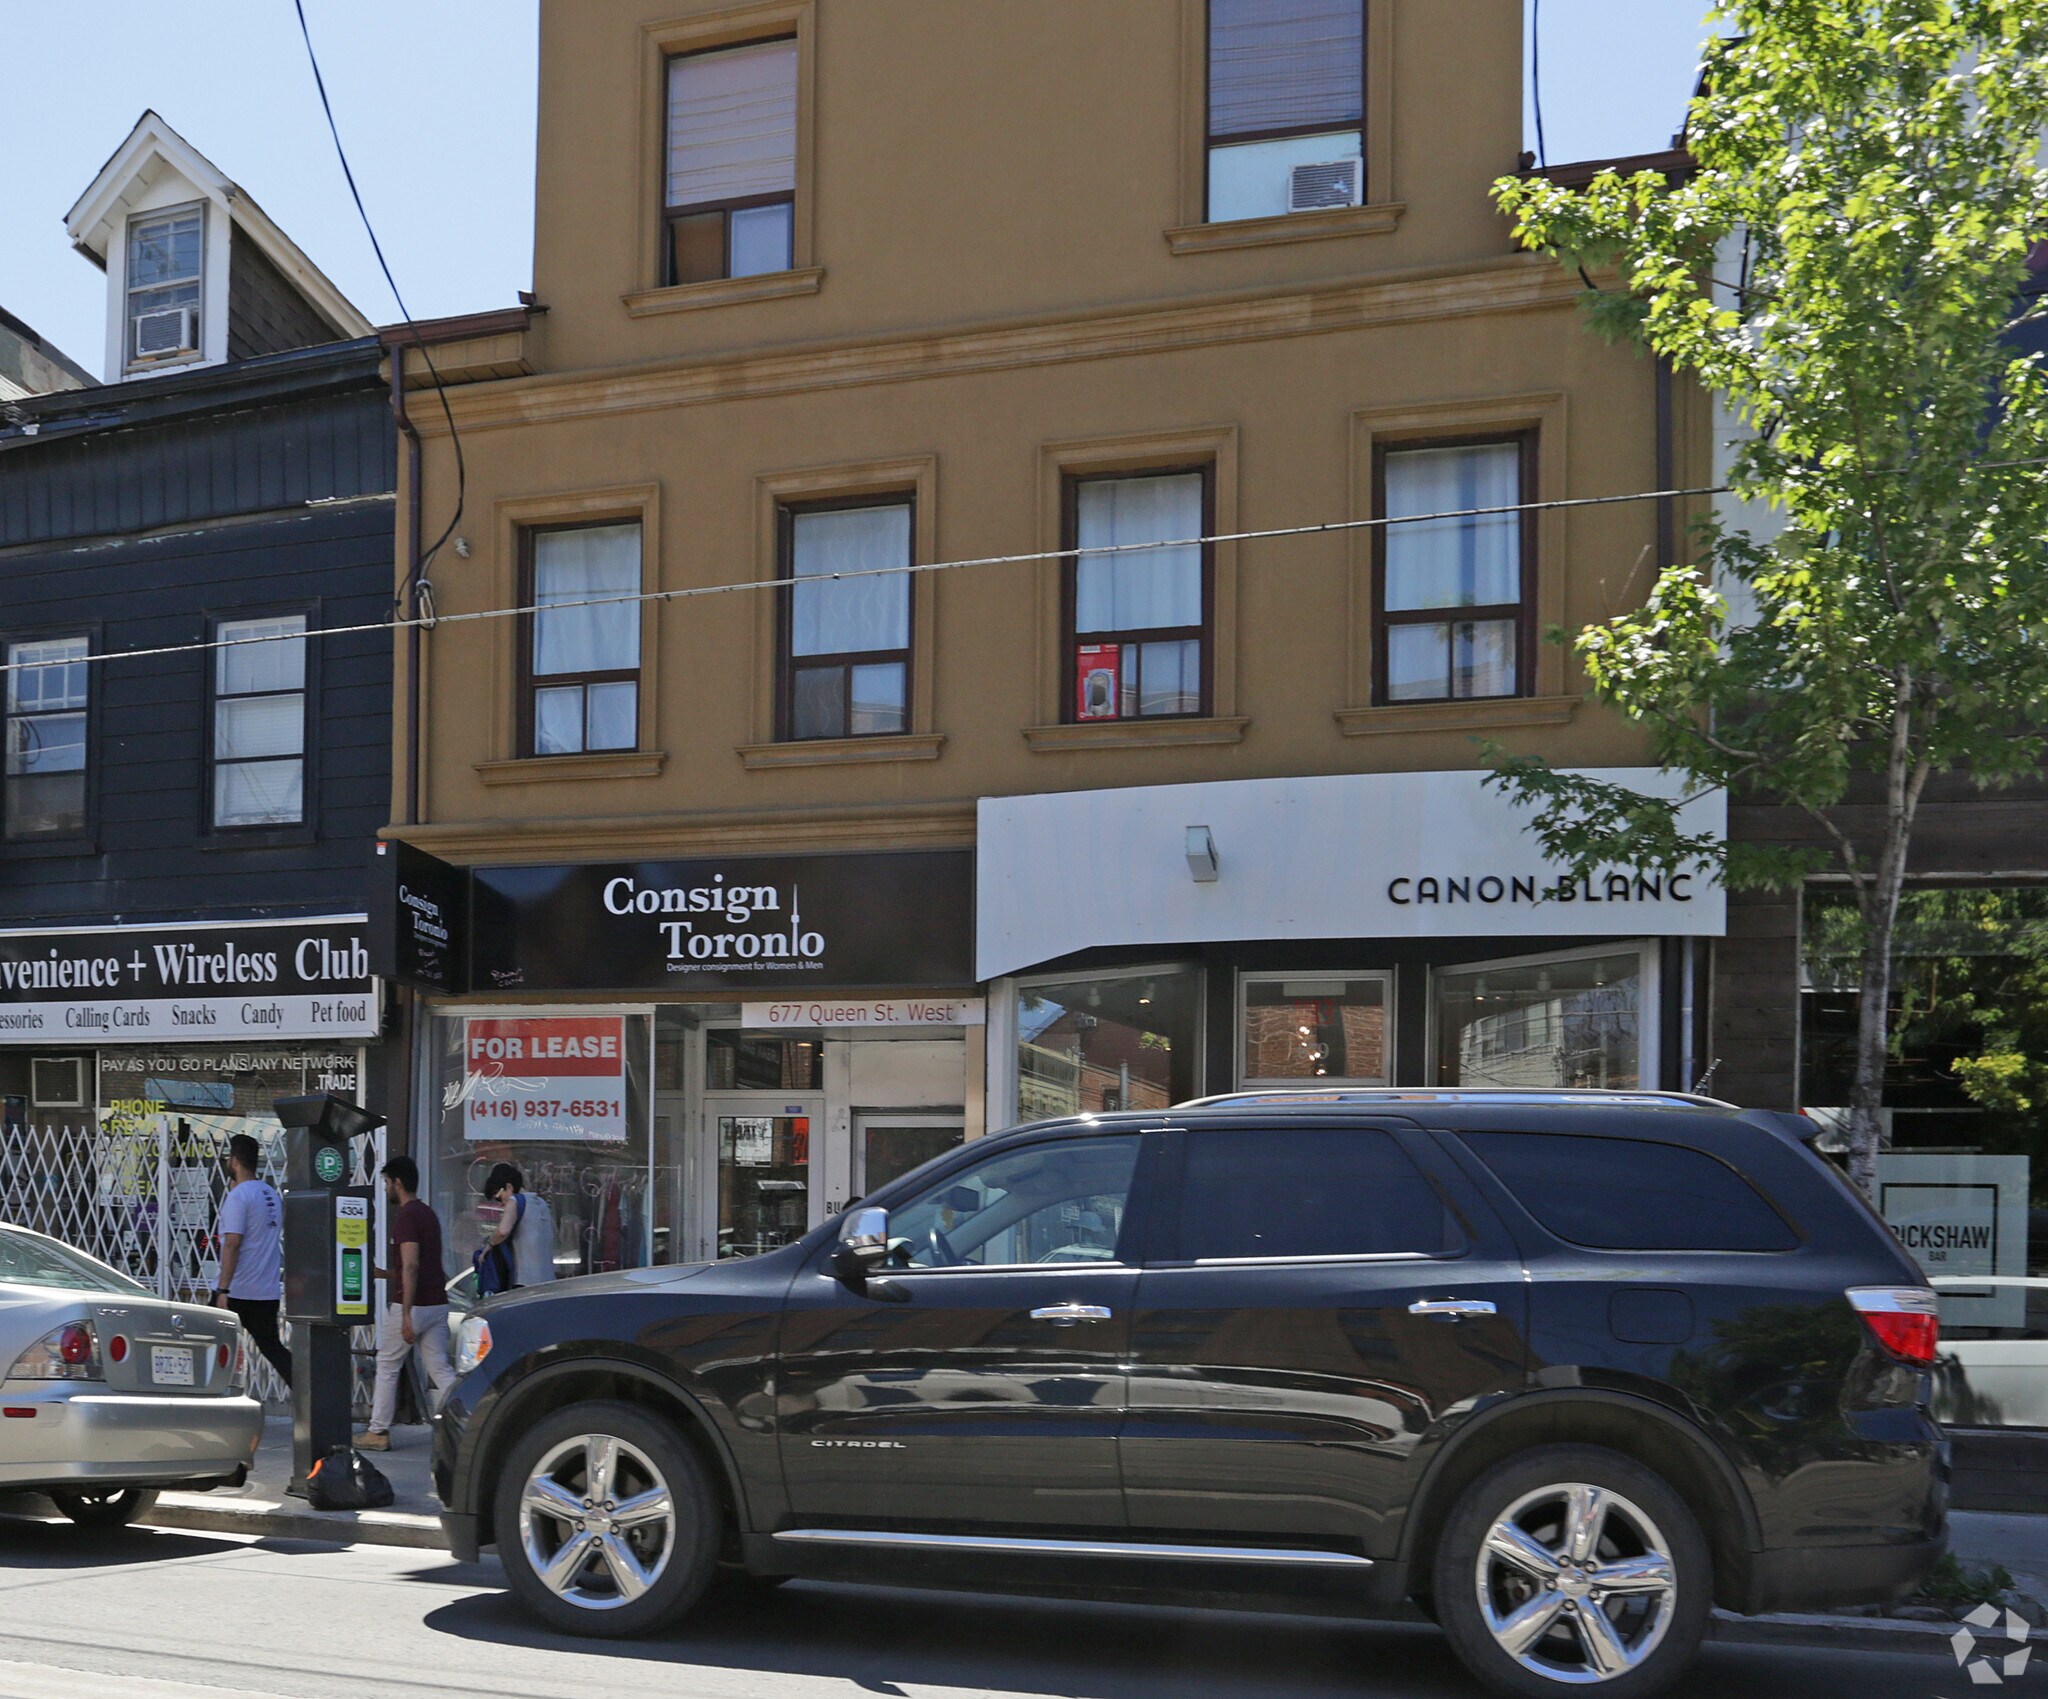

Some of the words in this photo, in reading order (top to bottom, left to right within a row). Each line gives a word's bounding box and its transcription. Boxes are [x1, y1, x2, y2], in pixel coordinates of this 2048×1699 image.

[603, 873, 780, 924] Consign
[1387, 875, 1535, 905] CANON
[1557, 874, 1692, 902] BLANC
[0, 948, 120, 990] venience
[153, 943, 277, 985] Wireless
[294, 937, 369, 981] Club
[667, 962, 701, 973] Designer
[702, 962, 752, 973] consignment
[754, 961, 766, 970] for
[765, 961, 797, 970] Women
[798, 961, 804, 970] &
[805, 961, 824, 970] Men
[65, 1007, 109, 1033] Calling
[112, 1006, 151, 1028] Cards
[172, 1004, 217, 1026] Snacks
[241, 1003, 285, 1030] Candy
[311, 1001, 333, 1023] Pet
[337, 1000, 367, 1023] food
[769, 1004, 802, 1023] 677
[809, 1003, 867, 1026] Queen
[874, 1003, 900, 1022] St.
[906, 1002, 954, 1022] West
[471, 1037, 523, 1060] FOR
[531, 1035, 618, 1059] LEASE
[101, 1059, 126, 1072] PAY
[126, 1059, 145, 1072] AS
[147, 1059, 177, 1072] YOU
[179, 1058, 201, 1071] GO
[203, 1058, 249, 1072] PLANS
[249, 1057, 280, 1071] ANY
[282, 1055, 355, 1070] NETWORK
[110, 1099, 166, 1115] PHONE
[470, 1100, 518, 1121] (416)
[524, 1099, 620, 1118] 937-6531
[340, 1206, 364, 1216] 4304
[1928, 1250, 1947, 1262] BAR
[810, 1440, 908, 1449] CITADEL
